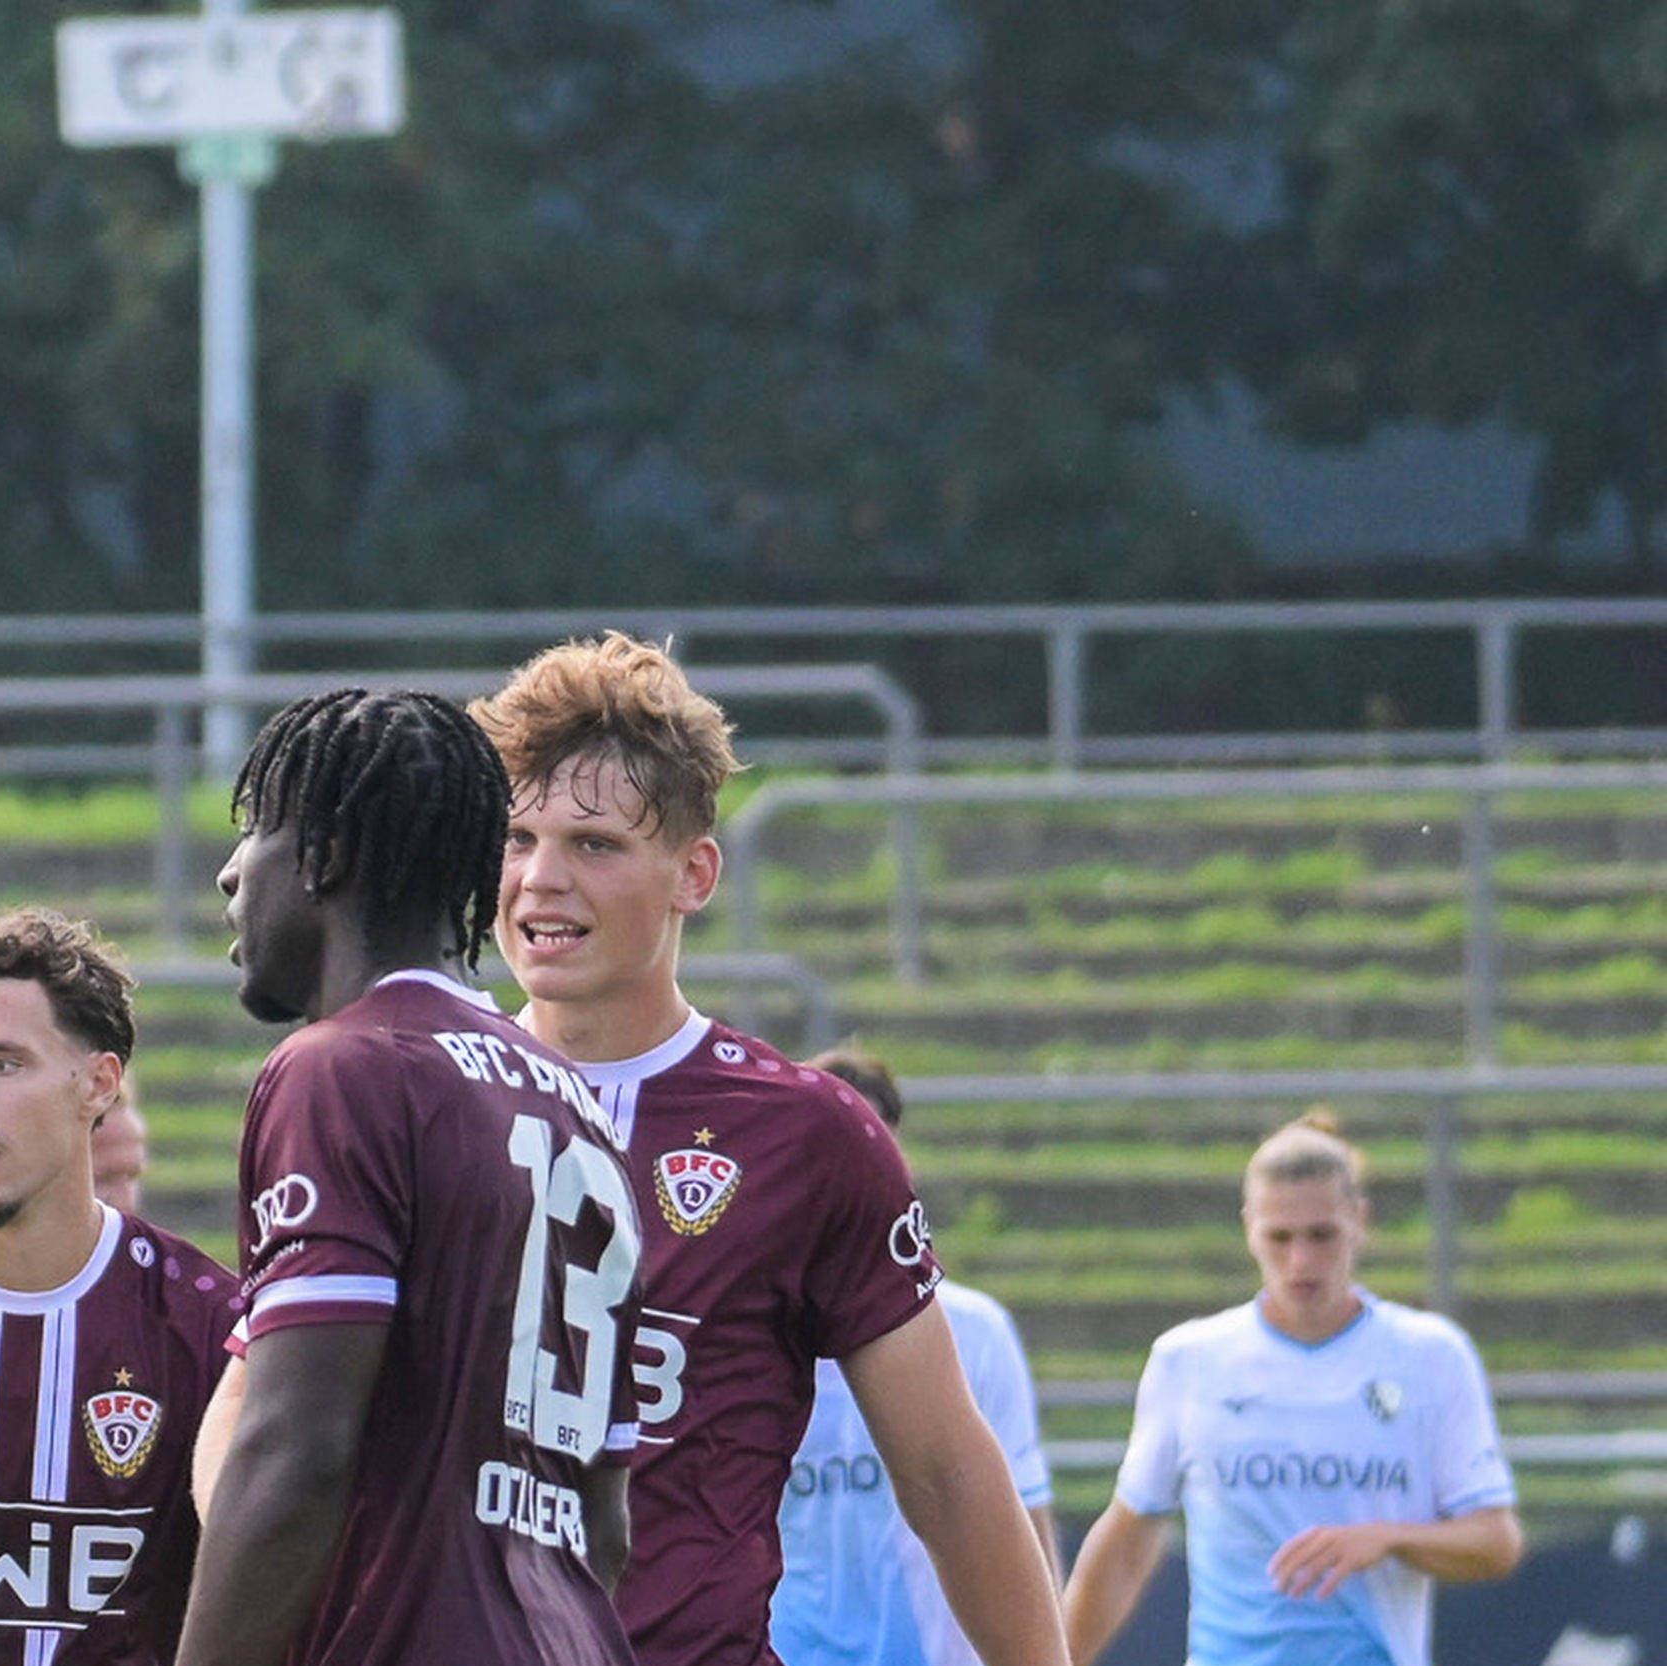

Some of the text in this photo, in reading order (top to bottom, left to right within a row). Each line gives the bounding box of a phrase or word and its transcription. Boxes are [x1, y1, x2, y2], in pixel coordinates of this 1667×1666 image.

[432, 1031, 524, 1088] BFC
[666, 1155, 732, 1182] BFC
[508, 1113, 643, 1465] 13
[92, 1396, 154, 1421] BFC
